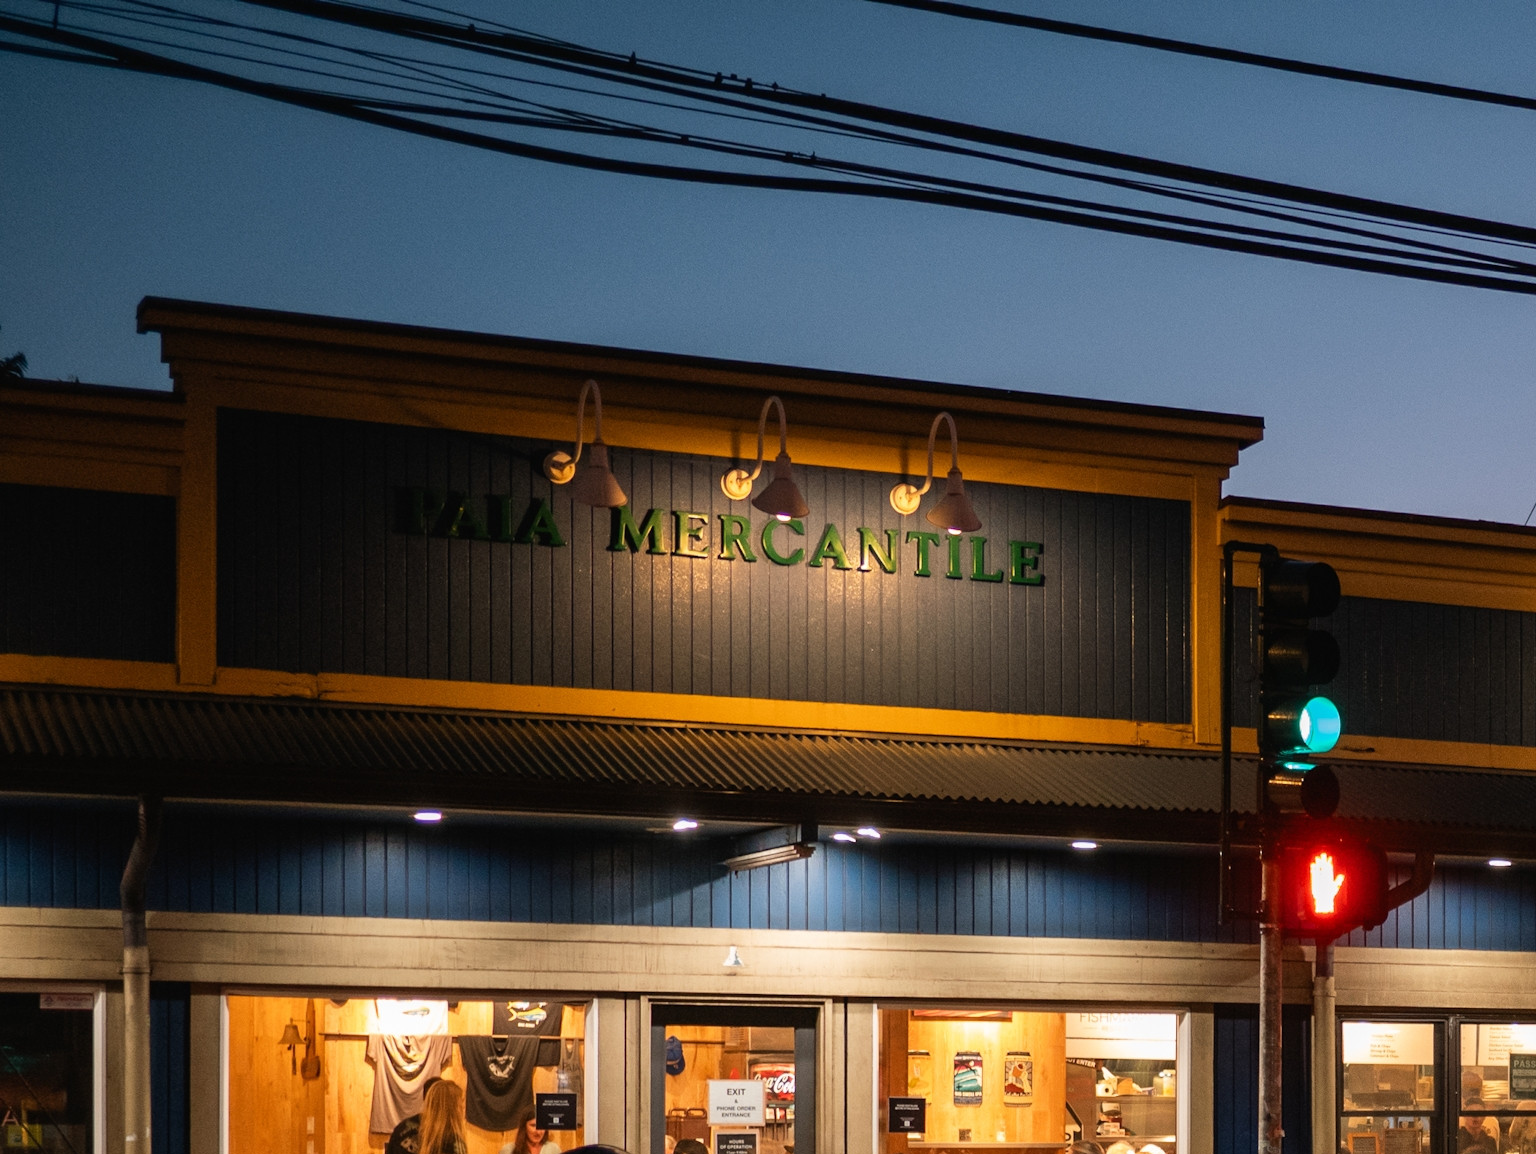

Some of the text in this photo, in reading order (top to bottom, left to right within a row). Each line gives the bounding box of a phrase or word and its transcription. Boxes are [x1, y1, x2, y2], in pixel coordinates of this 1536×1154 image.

[400, 486, 1046, 586] PAIA MERCANTILE
[1513, 1060, 1536, 1068] PASS
[727, 1088, 746, 1096] EXIT
